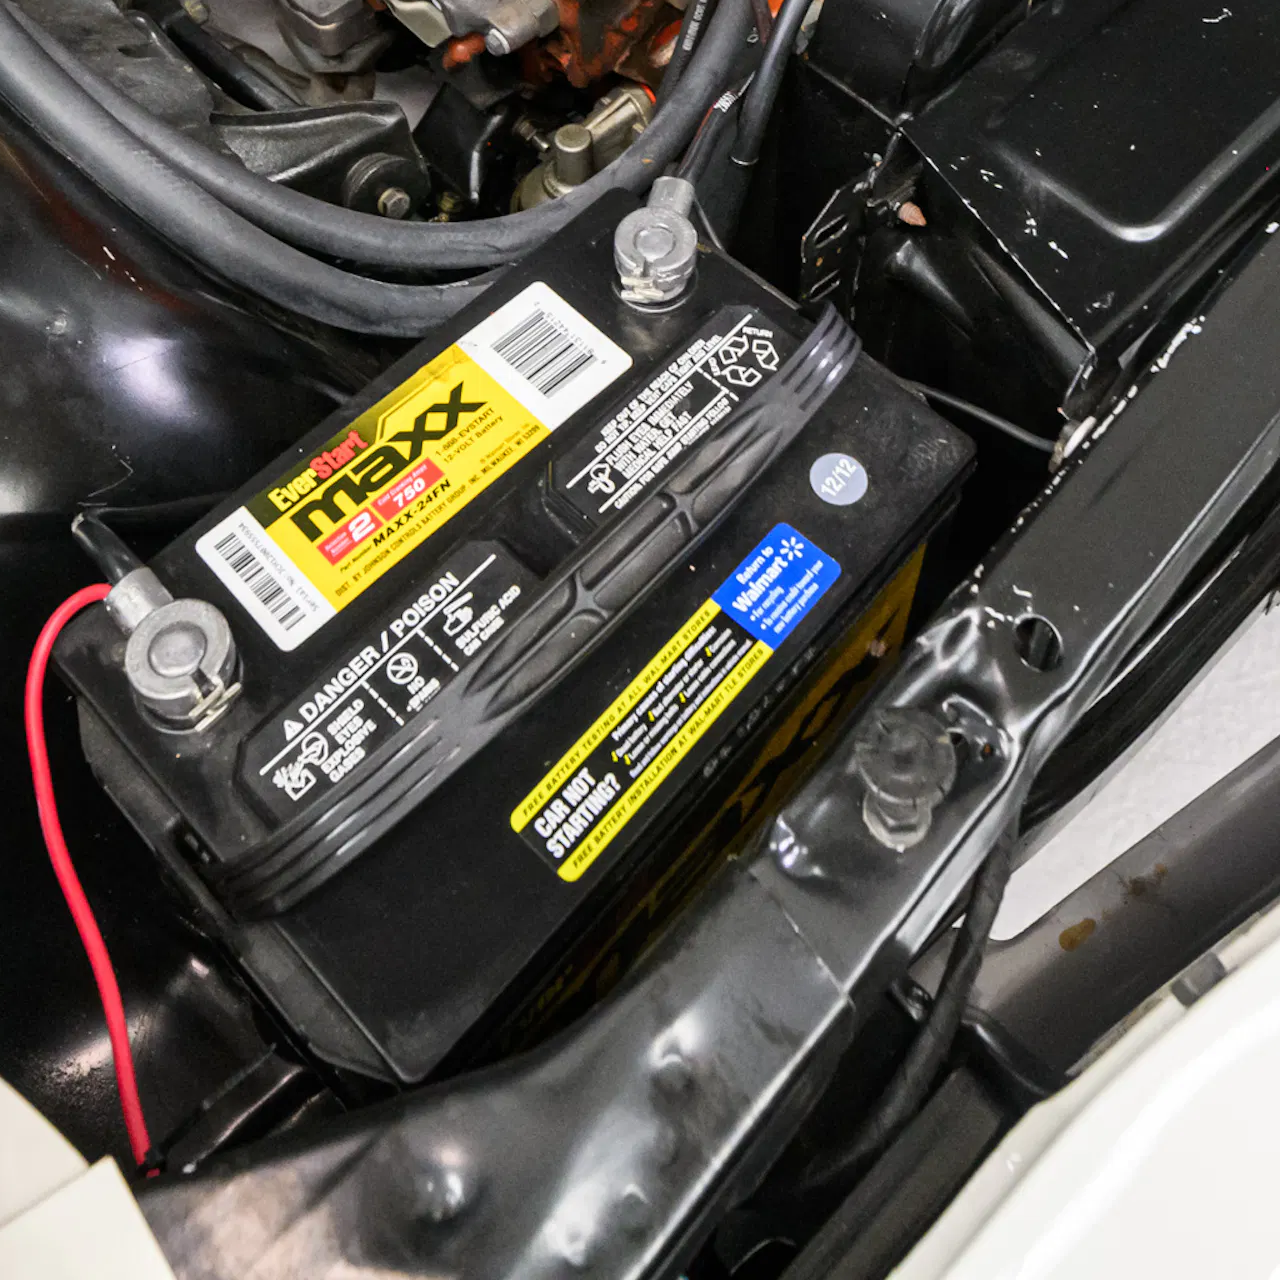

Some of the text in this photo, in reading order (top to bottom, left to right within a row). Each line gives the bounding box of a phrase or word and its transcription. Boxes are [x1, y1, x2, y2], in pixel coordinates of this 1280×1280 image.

[442, 413, 505, 464] 12-VOLT Battery
[603, 438, 634, 466] FLUSH
[626, 420, 653, 444] EYES
[645, 379, 696, 426] IMMEDIATELY
[611, 449, 638, 473] WITH
[656, 410, 679, 430] GET
[619, 445, 657, 479] MEDICAL
[650, 426, 676, 451] HELP
[668, 409, 694, 432] FAST
[265, 427, 371, 513] EverStart
[288, 379, 487, 543] maxx
[390, 475, 429, 509] 750
[820, 458, 856, 496] 12/12
[342, 509, 379, 543] 2
[360, 546, 392, 575] JOHNSON
[388, 521, 422, 551] CONTROLS
[419, 500, 447, 525] BATTERY
[370, 477, 453, 548] MAXX-24FN
[729, 552, 790, 615] Walmart
[733, 542, 776, 586] Return to
[296, 642, 383, 724] DANGER
[387, 569, 461, 639] POISON
[452, 582, 524, 651] SULFURIC ACID
[324, 696, 367, 737] SHIELD
[404, 672, 428, 696] NO
[521, 790, 546, 817] FREE
[543, 749, 583, 792] BATTERY
[580, 712, 616, 751] TESTING
[614, 699, 628, 715] AT
[625, 684, 643, 702] ALL
[680, 608, 712, 641] STORES
[317, 717, 379, 775] EXPLOSIVE
[332, 713, 365, 745] EYES
[570, 842, 595, 869] FREE
[591, 803, 628, 845] BATTERY
[624, 745, 679, 806] INSTALLATION
[675, 733, 689, 748] AT
[734, 646, 765, 680] STORES
[326, 744, 368, 785] GASES
[530, 764, 600, 841] CAR NOT
[542, 769, 625, 861] STARTING?
